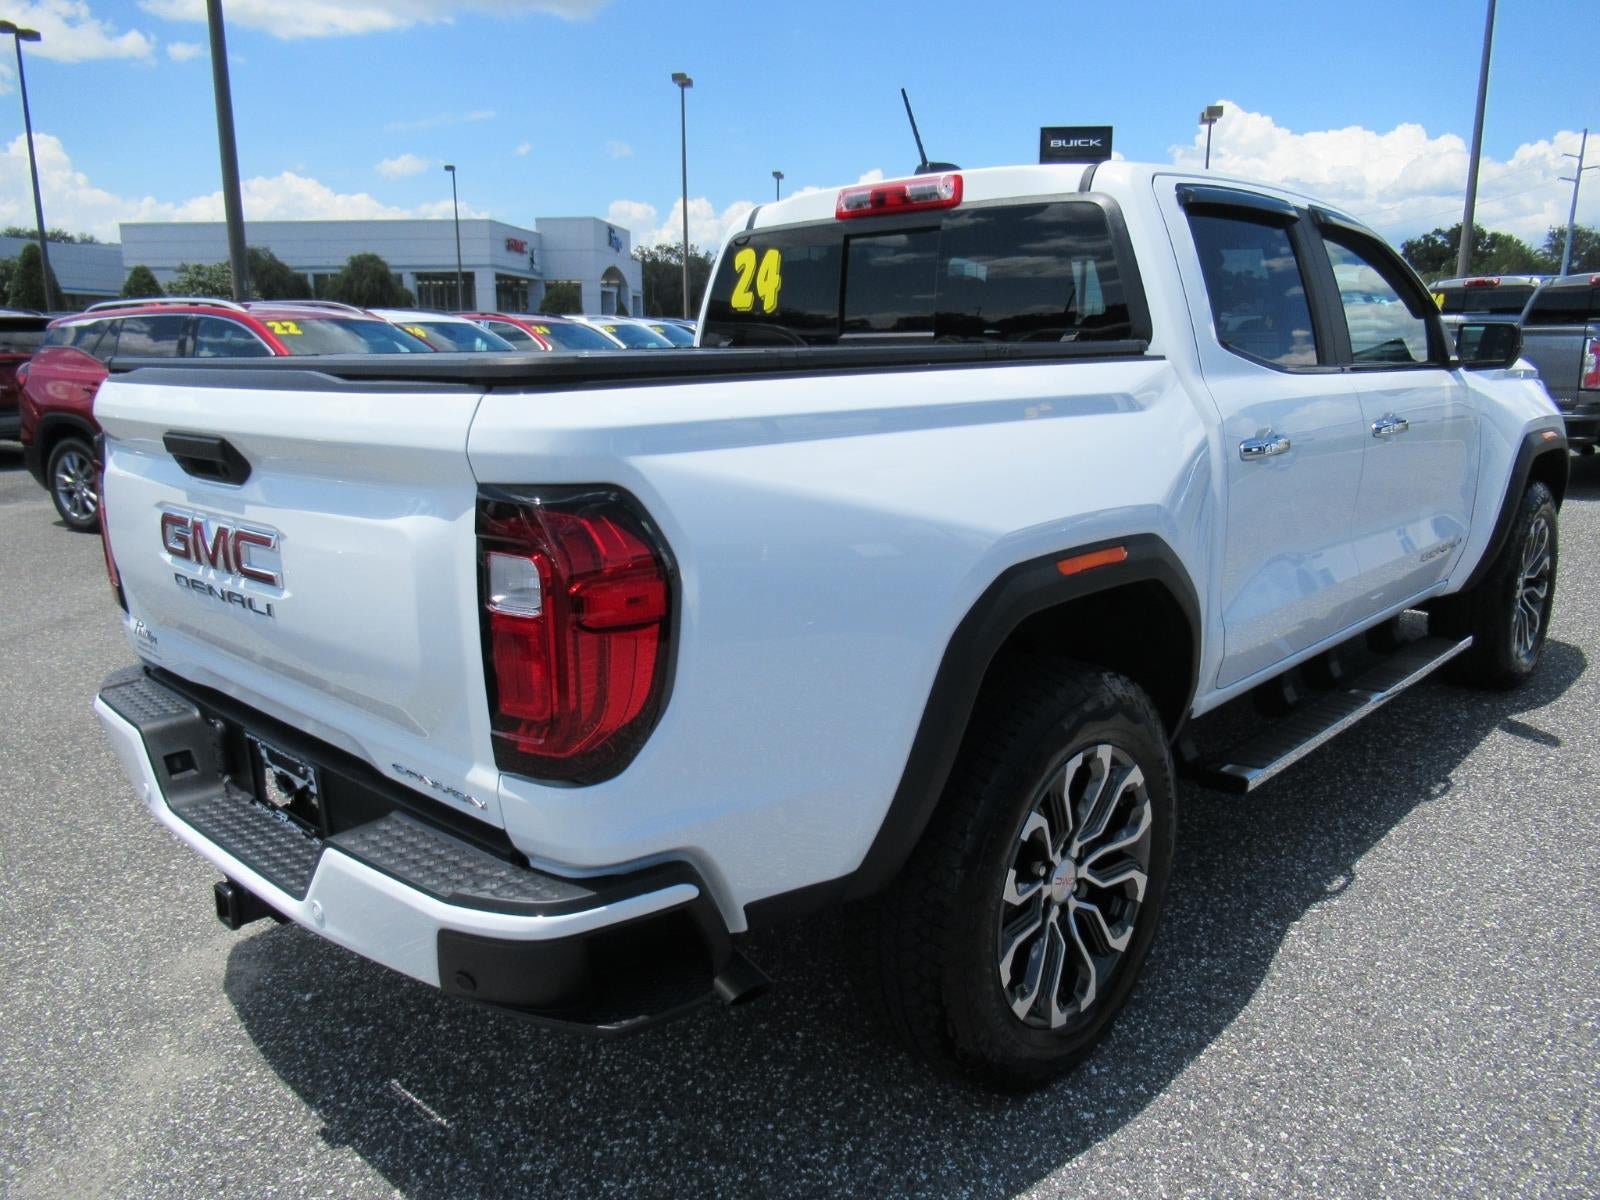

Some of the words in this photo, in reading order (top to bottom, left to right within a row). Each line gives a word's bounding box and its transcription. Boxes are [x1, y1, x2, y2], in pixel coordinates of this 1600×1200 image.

[1050, 139, 1102, 148] BUICK
[731, 247, 781, 314] 24
[266, 320, 303, 336] 22
[160, 511, 281, 590] GMC
[174, 572, 275, 617] DENALI
[391, 763, 488, 810] CANYON
